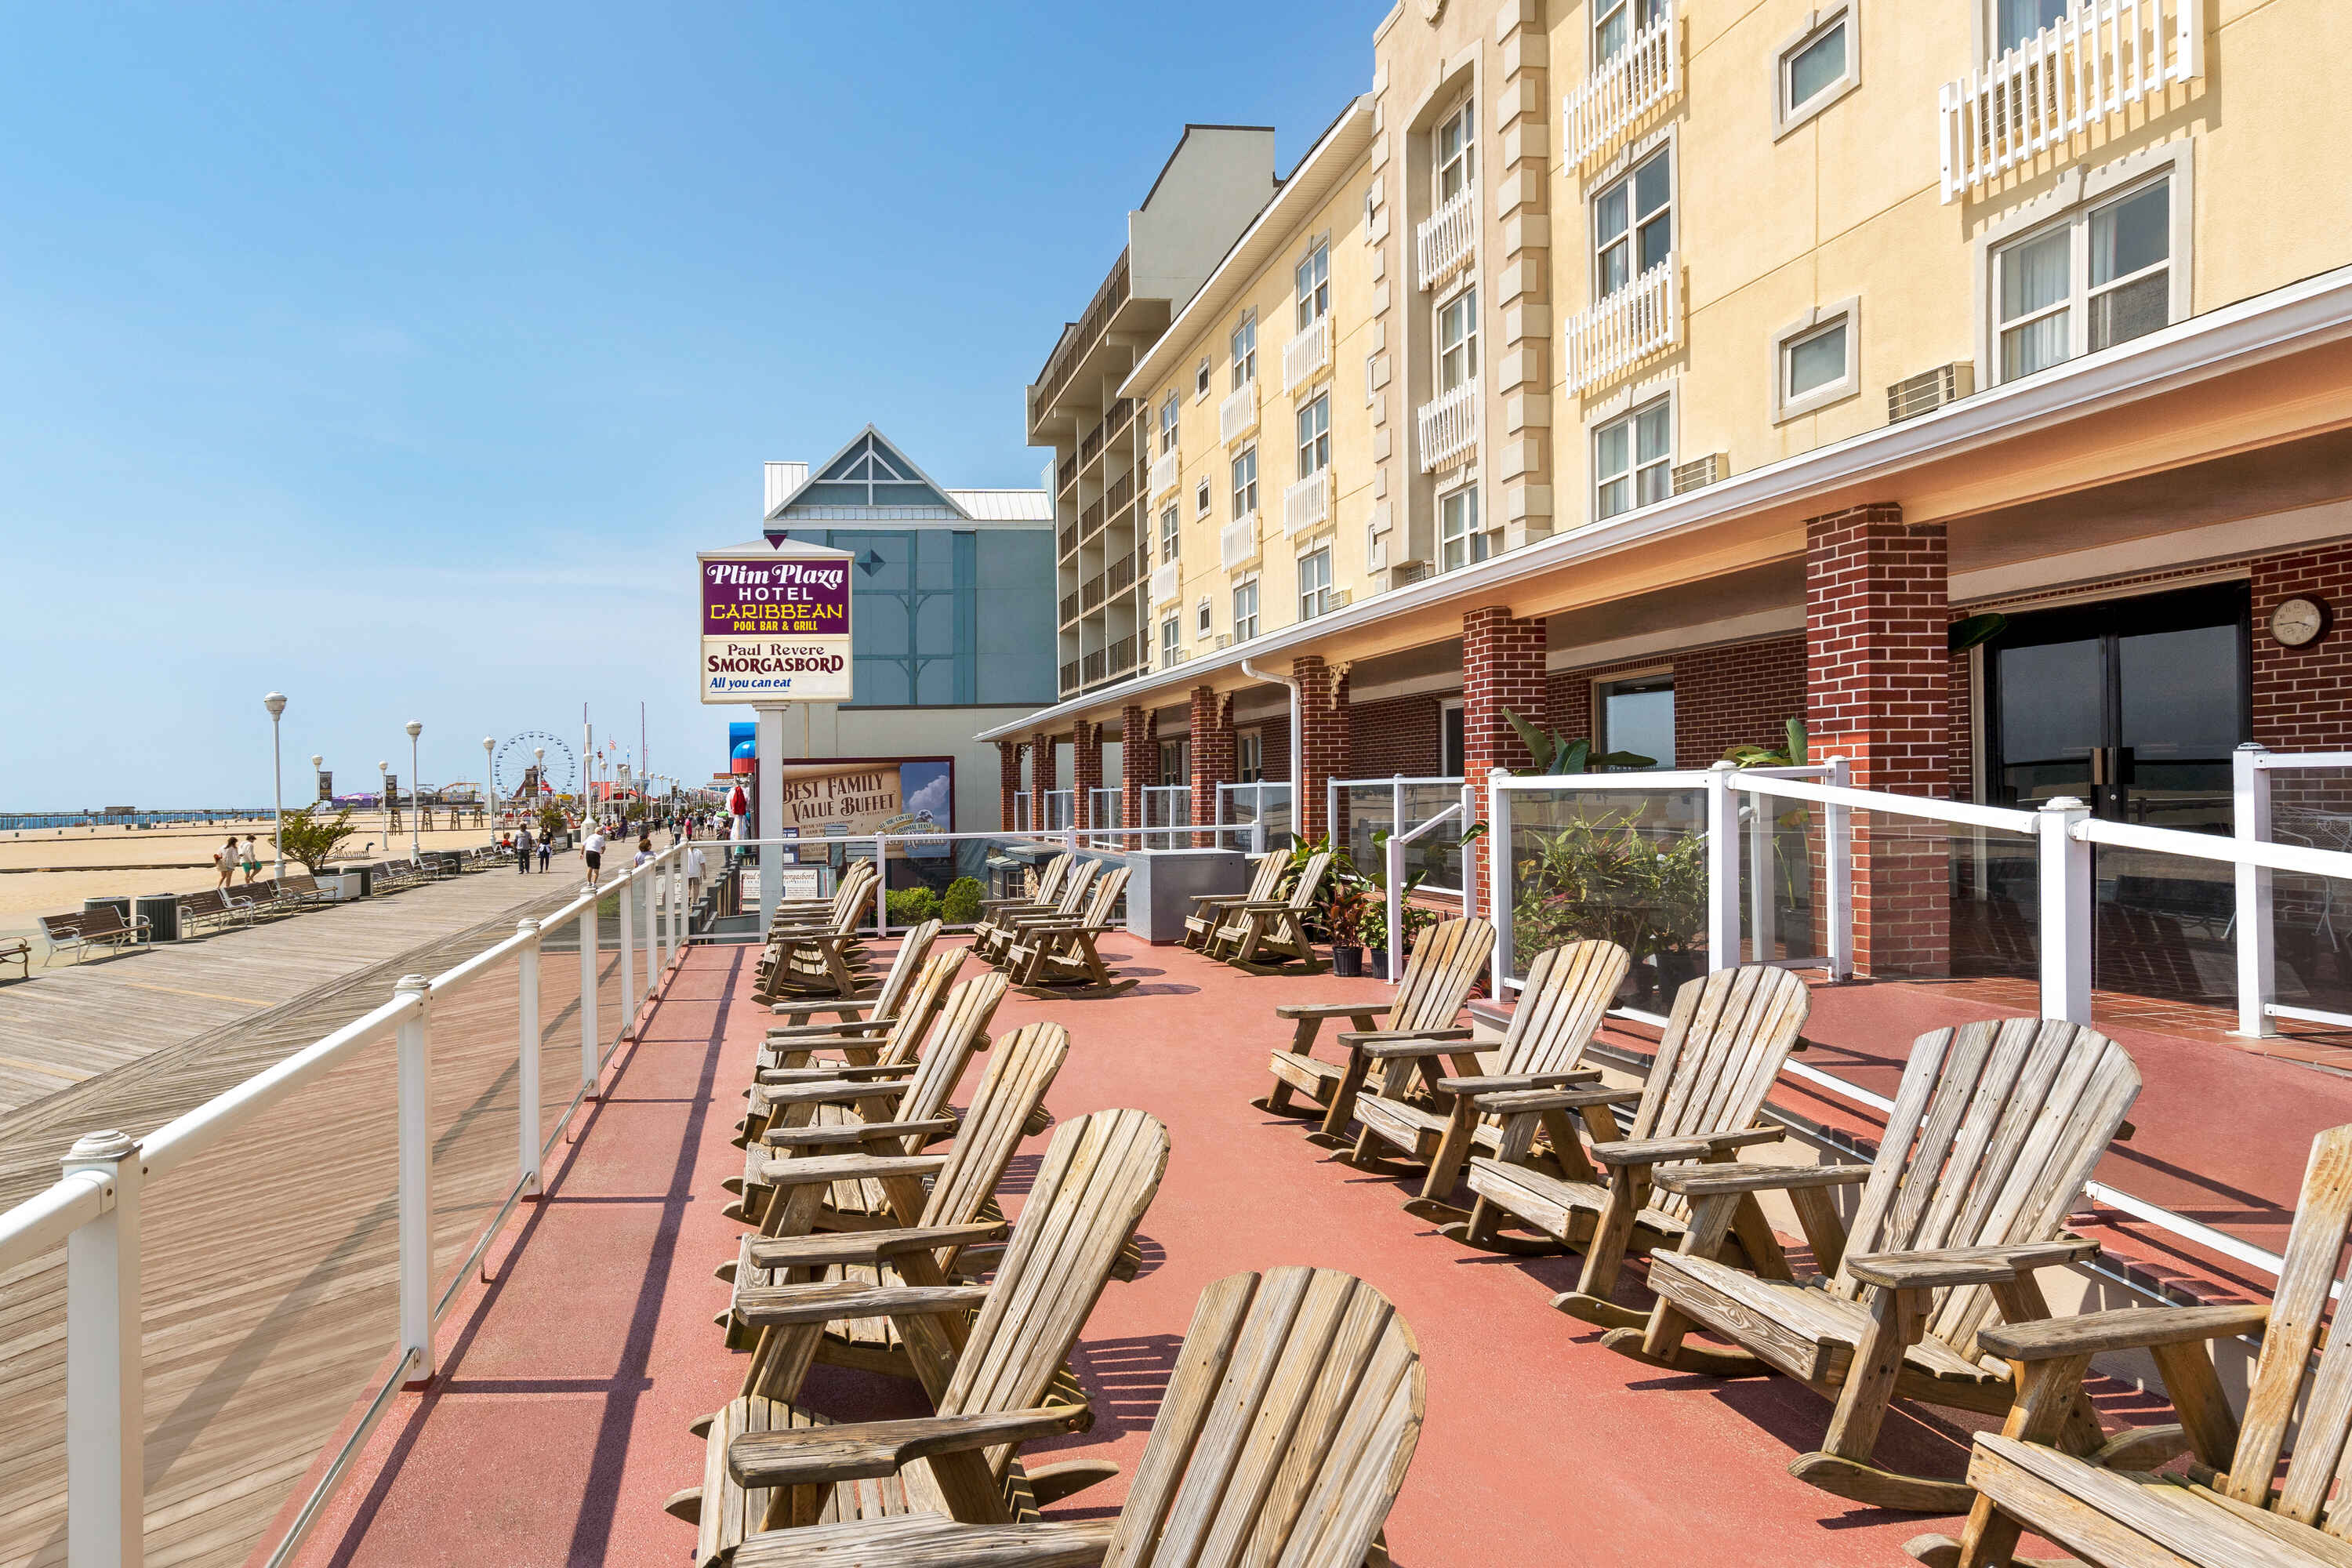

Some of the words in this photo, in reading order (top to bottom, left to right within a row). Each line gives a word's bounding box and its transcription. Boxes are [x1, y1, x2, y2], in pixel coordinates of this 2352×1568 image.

[706, 564, 770, 584] Plim
[771, 564, 844, 590] Plaza
[739, 587, 814, 601] HOTEL
[710, 603, 844, 619] CARIBBEAN
[734, 621, 756, 631] POOL
[760, 621, 779, 631] BAR
[782, 621, 789, 631] &
[793, 621, 818, 631] GRILL
[728, 643, 761, 656] Paul
[770, 643, 825, 656] Revere
[708, 655, 844, 674] SMORGASBORD
[710, 677, 726, 688] All
[728, 678, 749, 691] you
[751, 678, 771, 688] can
[773, 677, 793, 688] eat
[783, 780, 820, 804] BEST
[827, 772, 884, 800] FAMILY
[792, 800, 835, 823] VALUE
[840, 793, 895, 817] BUFFET
